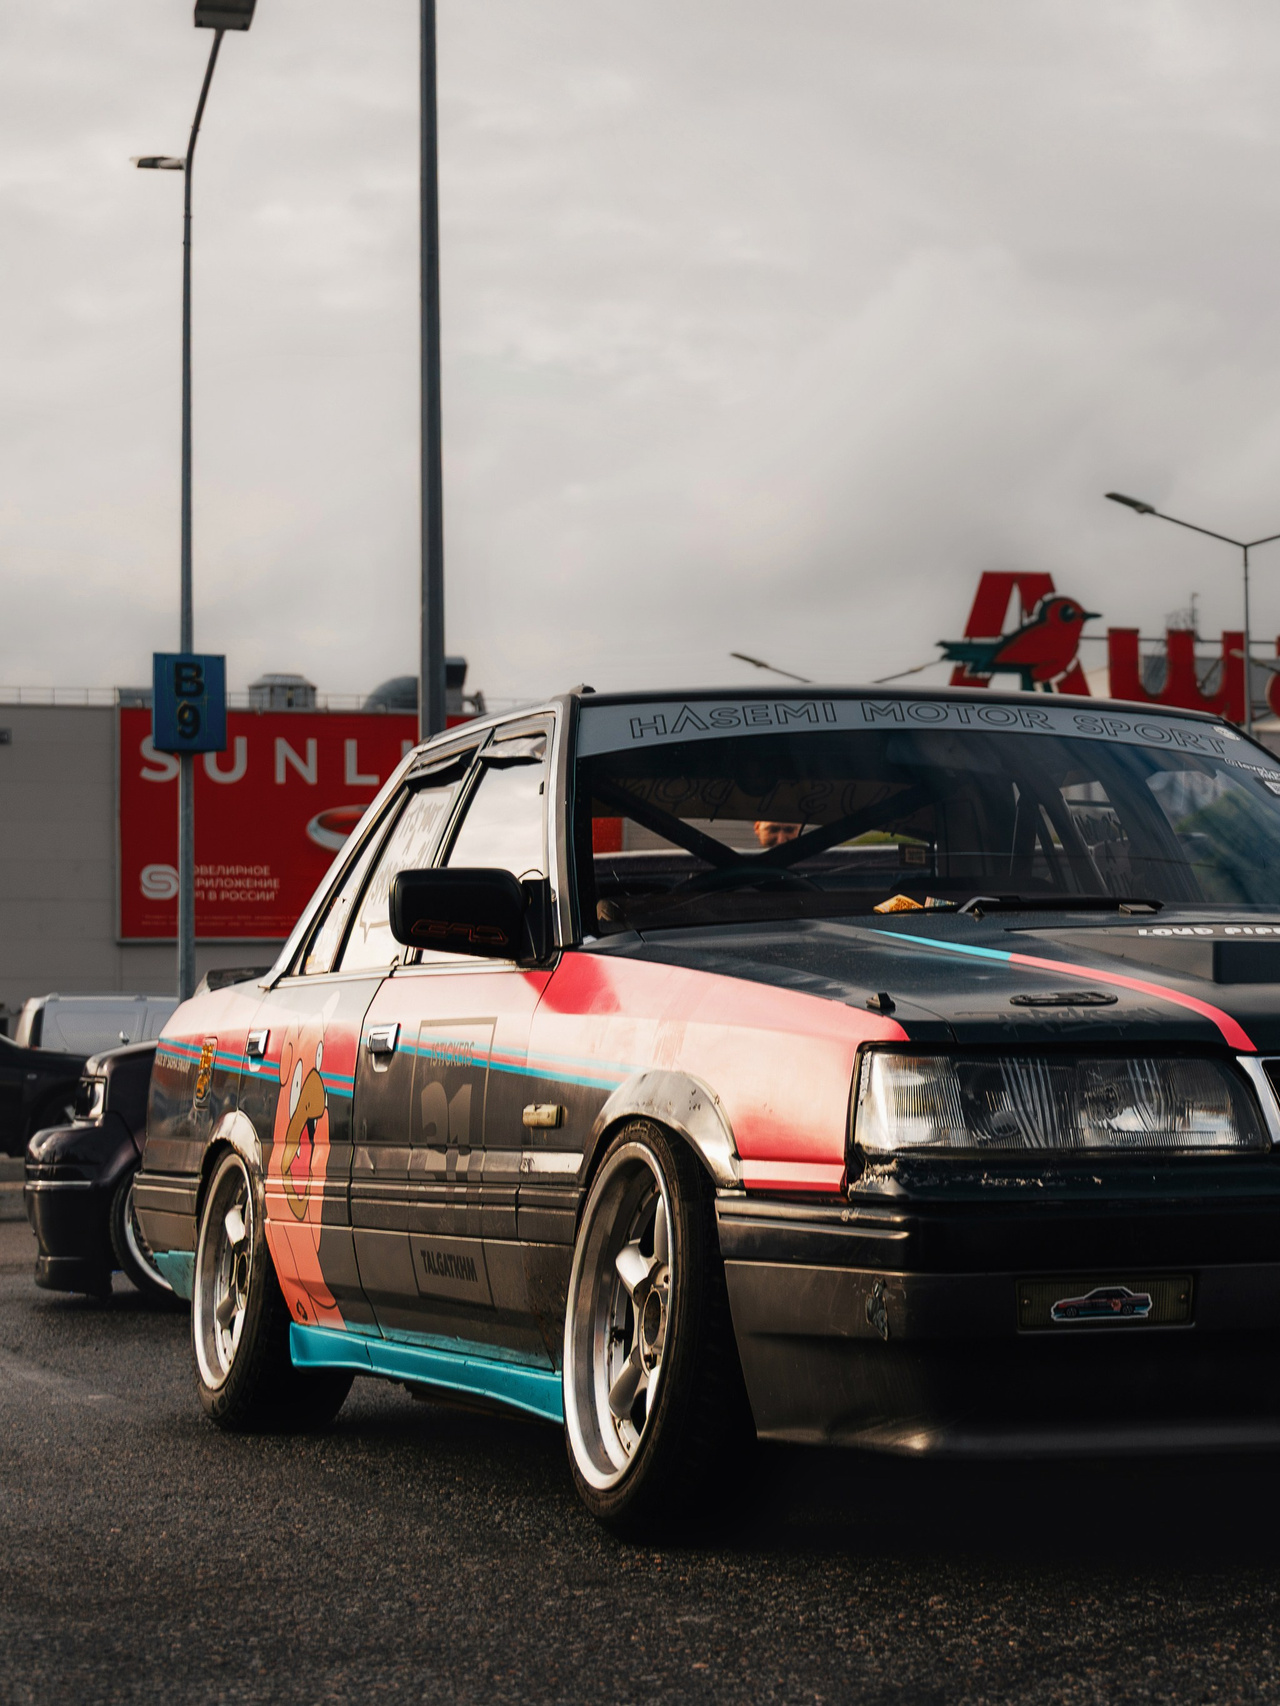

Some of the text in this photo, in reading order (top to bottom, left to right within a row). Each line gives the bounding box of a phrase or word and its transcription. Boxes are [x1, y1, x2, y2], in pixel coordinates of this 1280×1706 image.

[176, 703, 202, 740] 9
[861, 700, 1055, 731] MOTOR
[1073, 713, 1227, 755] SPORT
[196, 877, 281, 889] РИЛОЖЕНИЕ
[1137, 926, 1214, 936] LOUD
